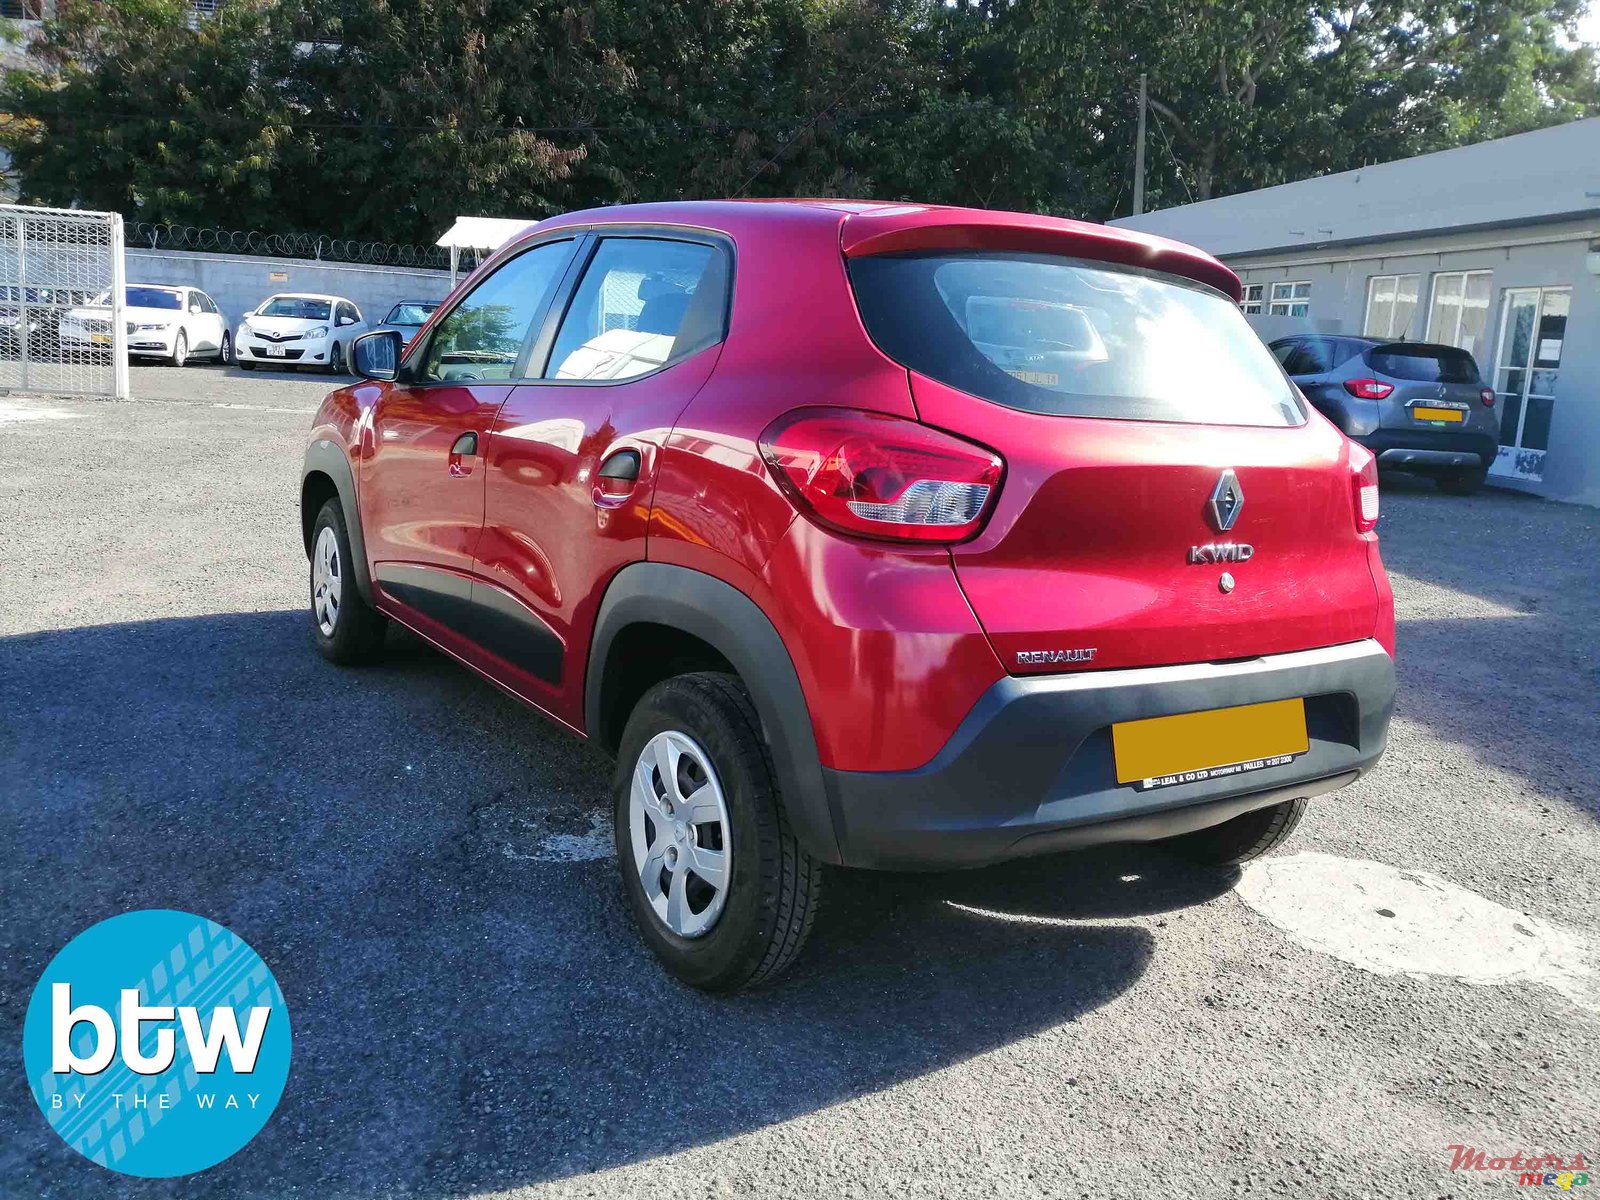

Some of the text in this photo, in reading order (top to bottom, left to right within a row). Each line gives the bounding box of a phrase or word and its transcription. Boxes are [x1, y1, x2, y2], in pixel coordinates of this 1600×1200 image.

[1189, 543, 1254, 565] KWID
[1016, 648, 1098, 664] RENAULT
[1161, 776, 1177, 785] LEAL
[1185, 773, 1195, 781] CO
[1197, 771, 1208, 779] LTD
[1210, 767, 1235, 777] MOTORWAY
[1243, 760, 1264, 771] PAILLES
